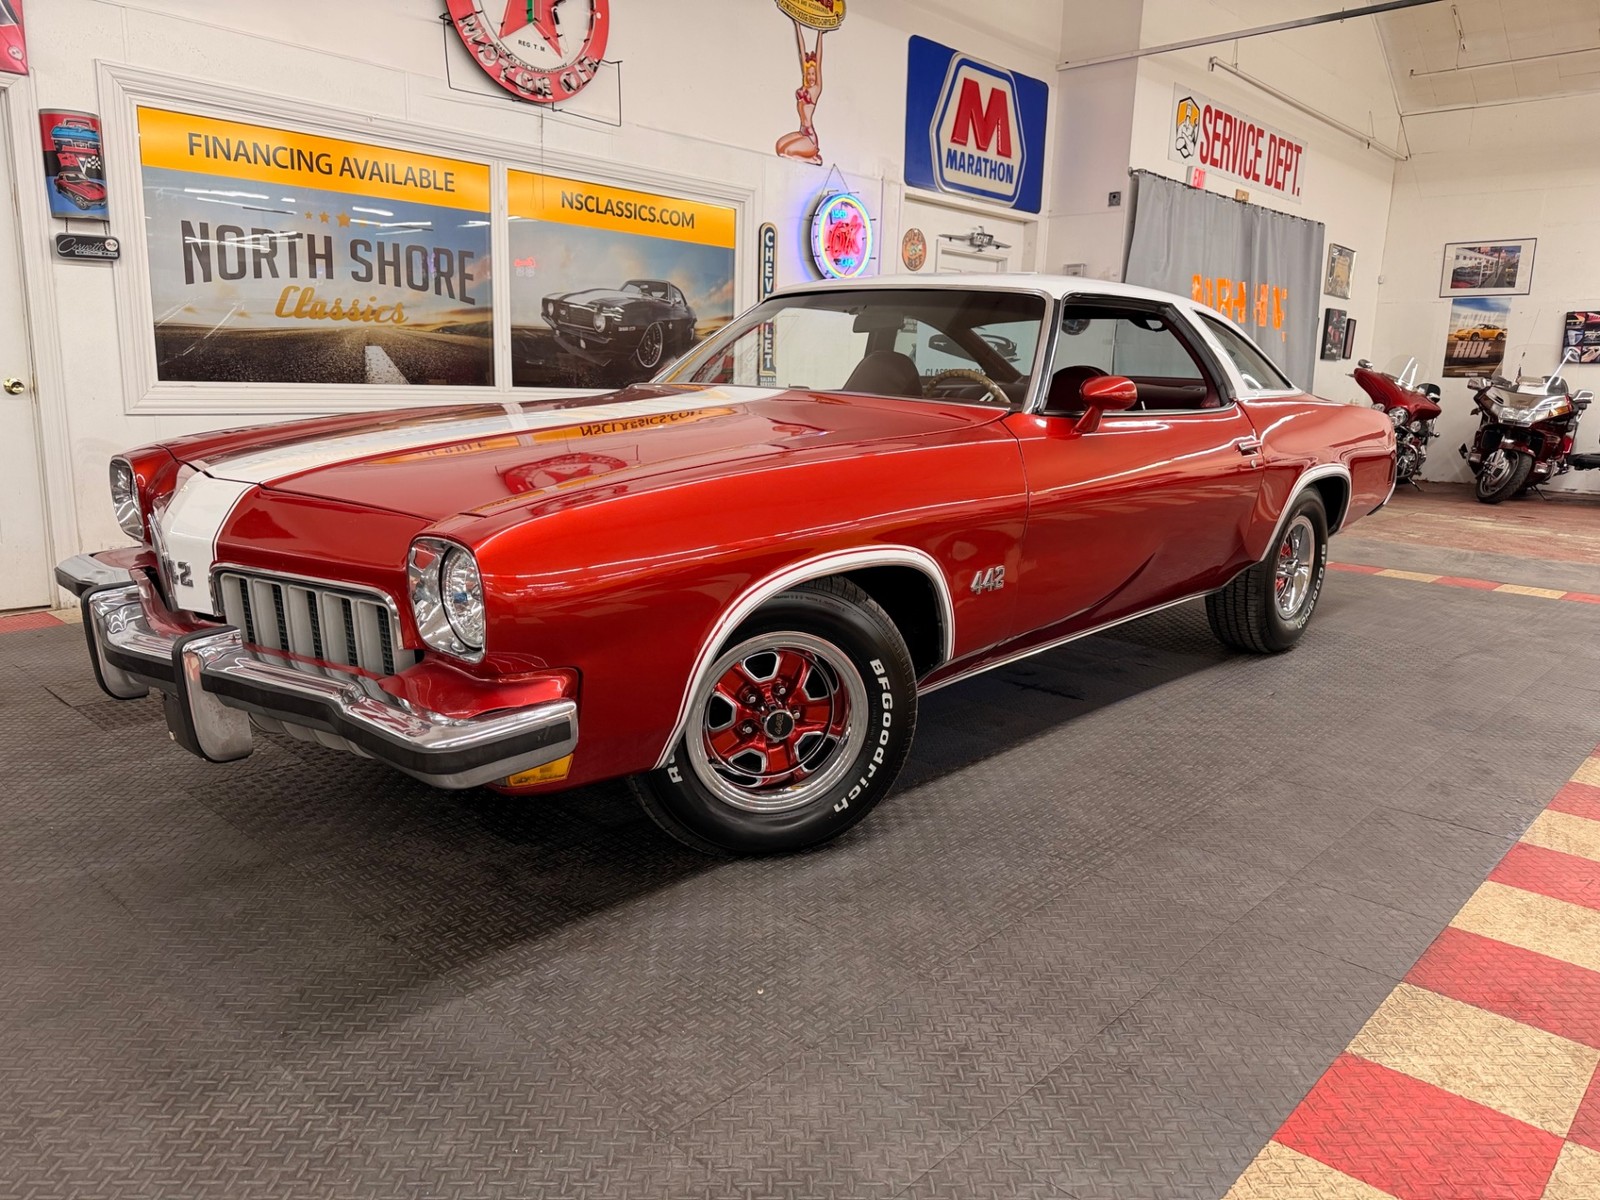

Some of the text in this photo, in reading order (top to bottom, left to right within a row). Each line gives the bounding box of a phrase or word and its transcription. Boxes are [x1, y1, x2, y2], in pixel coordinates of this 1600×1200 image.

[458, 17, 553, 99] MOTOR
[950, 77, 1012, 159] M
[187, 131, 456, 193] FINANCING AVAILABLE
[945, 147, 1014, 185] MARATHON
[1199, 104, 1303, 197] SERVICE DEPT.
[560, 190, 695, 229] NSCLASSICS.COM
[57, 237, 107, 253] Corvette
[180, 219, 476, 306] NORTH SHORE
[274, 284, 409, 325] Classics
[1452, 340, 1492, 358] RIDE
[971, 565, 1005, 595] 442
[1296, 543, 1327, 629] BFGoodrich
[833, 658, 893, 814] BFGoodrich
